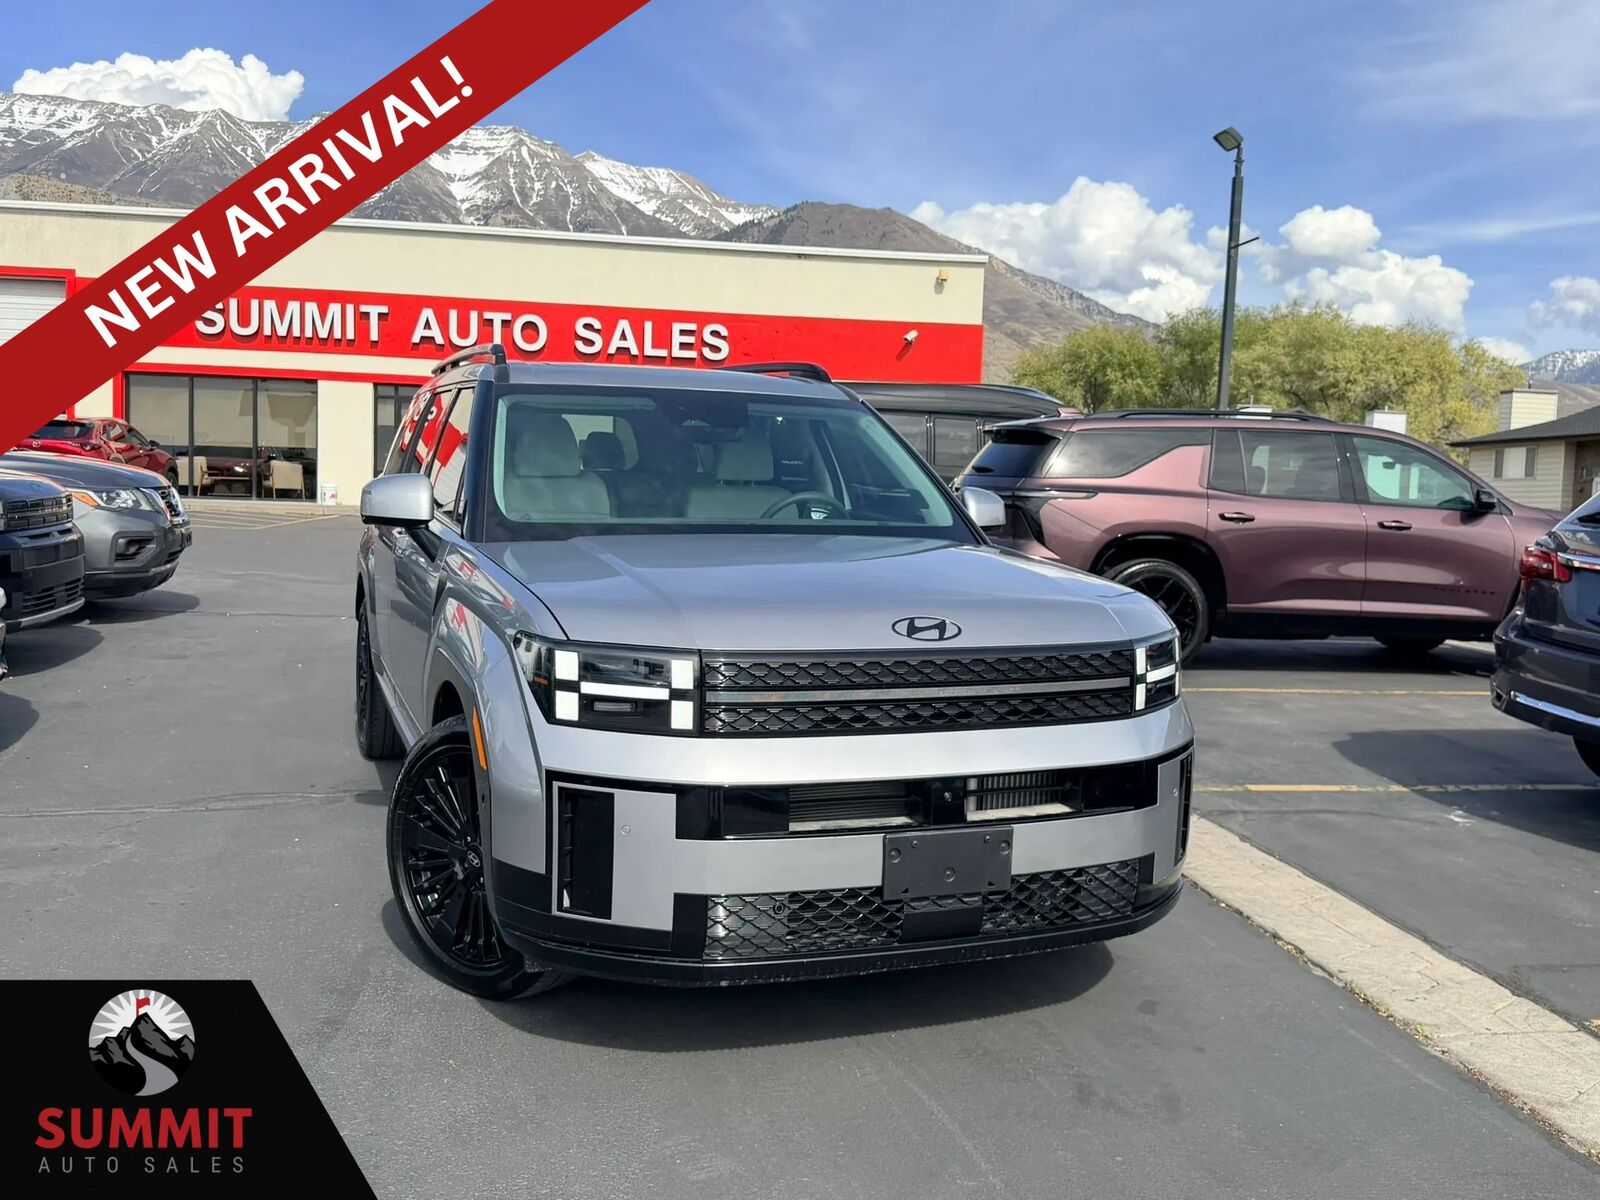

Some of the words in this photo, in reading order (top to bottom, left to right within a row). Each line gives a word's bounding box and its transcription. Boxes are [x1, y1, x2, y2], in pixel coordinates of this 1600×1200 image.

[194, 297, 389, 342] SUMMIT
[411, 307, 548, 352] AUTO
[574, 316, 730, 361] SALES
